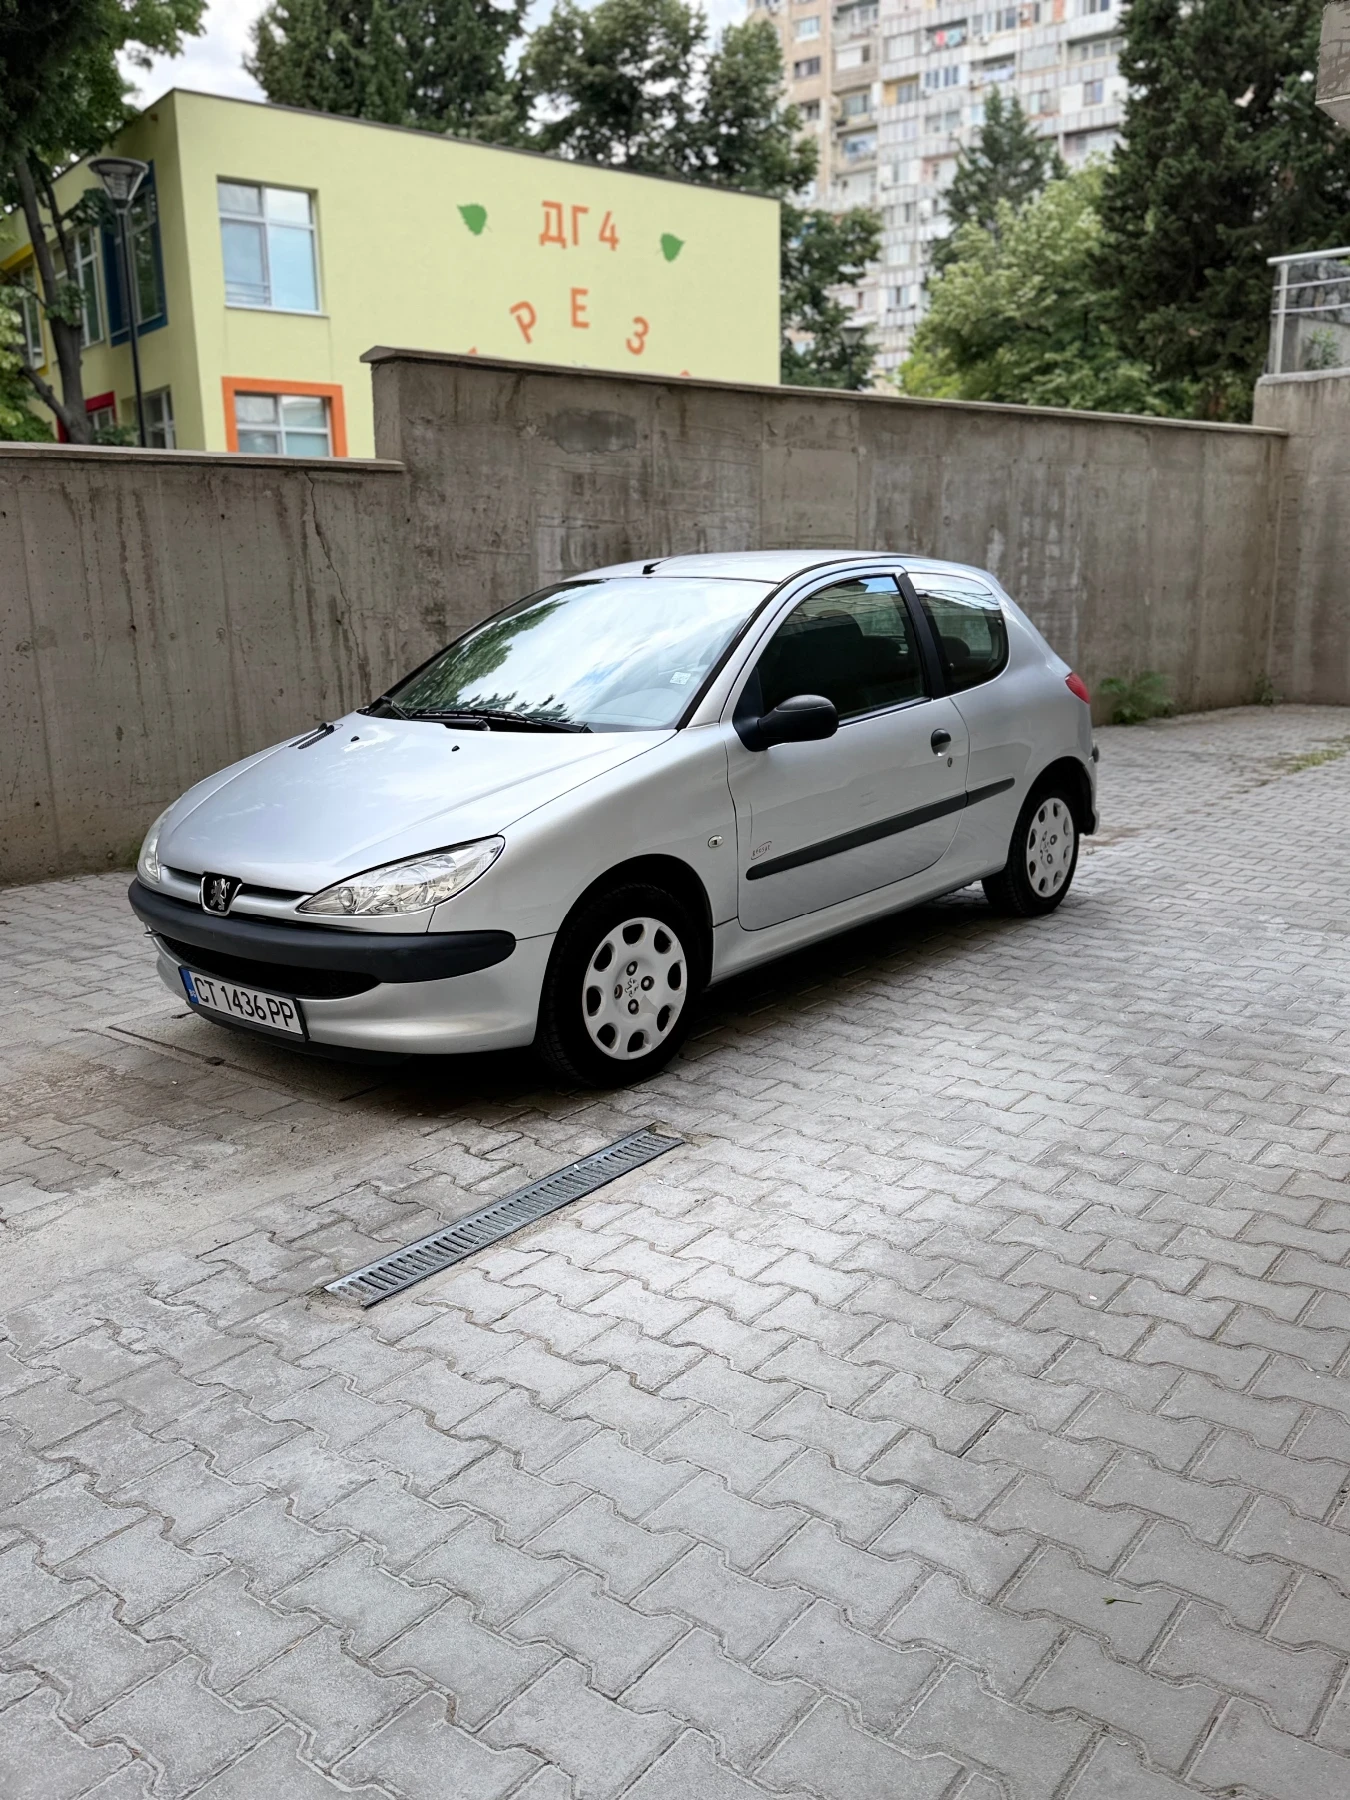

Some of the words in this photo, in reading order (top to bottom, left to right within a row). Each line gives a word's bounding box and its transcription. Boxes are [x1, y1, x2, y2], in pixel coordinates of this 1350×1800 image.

[540, 200, 589, 249] ДГ
[599, 211, 620, 251] 4
[221, 985, 267, 1020] 1436
